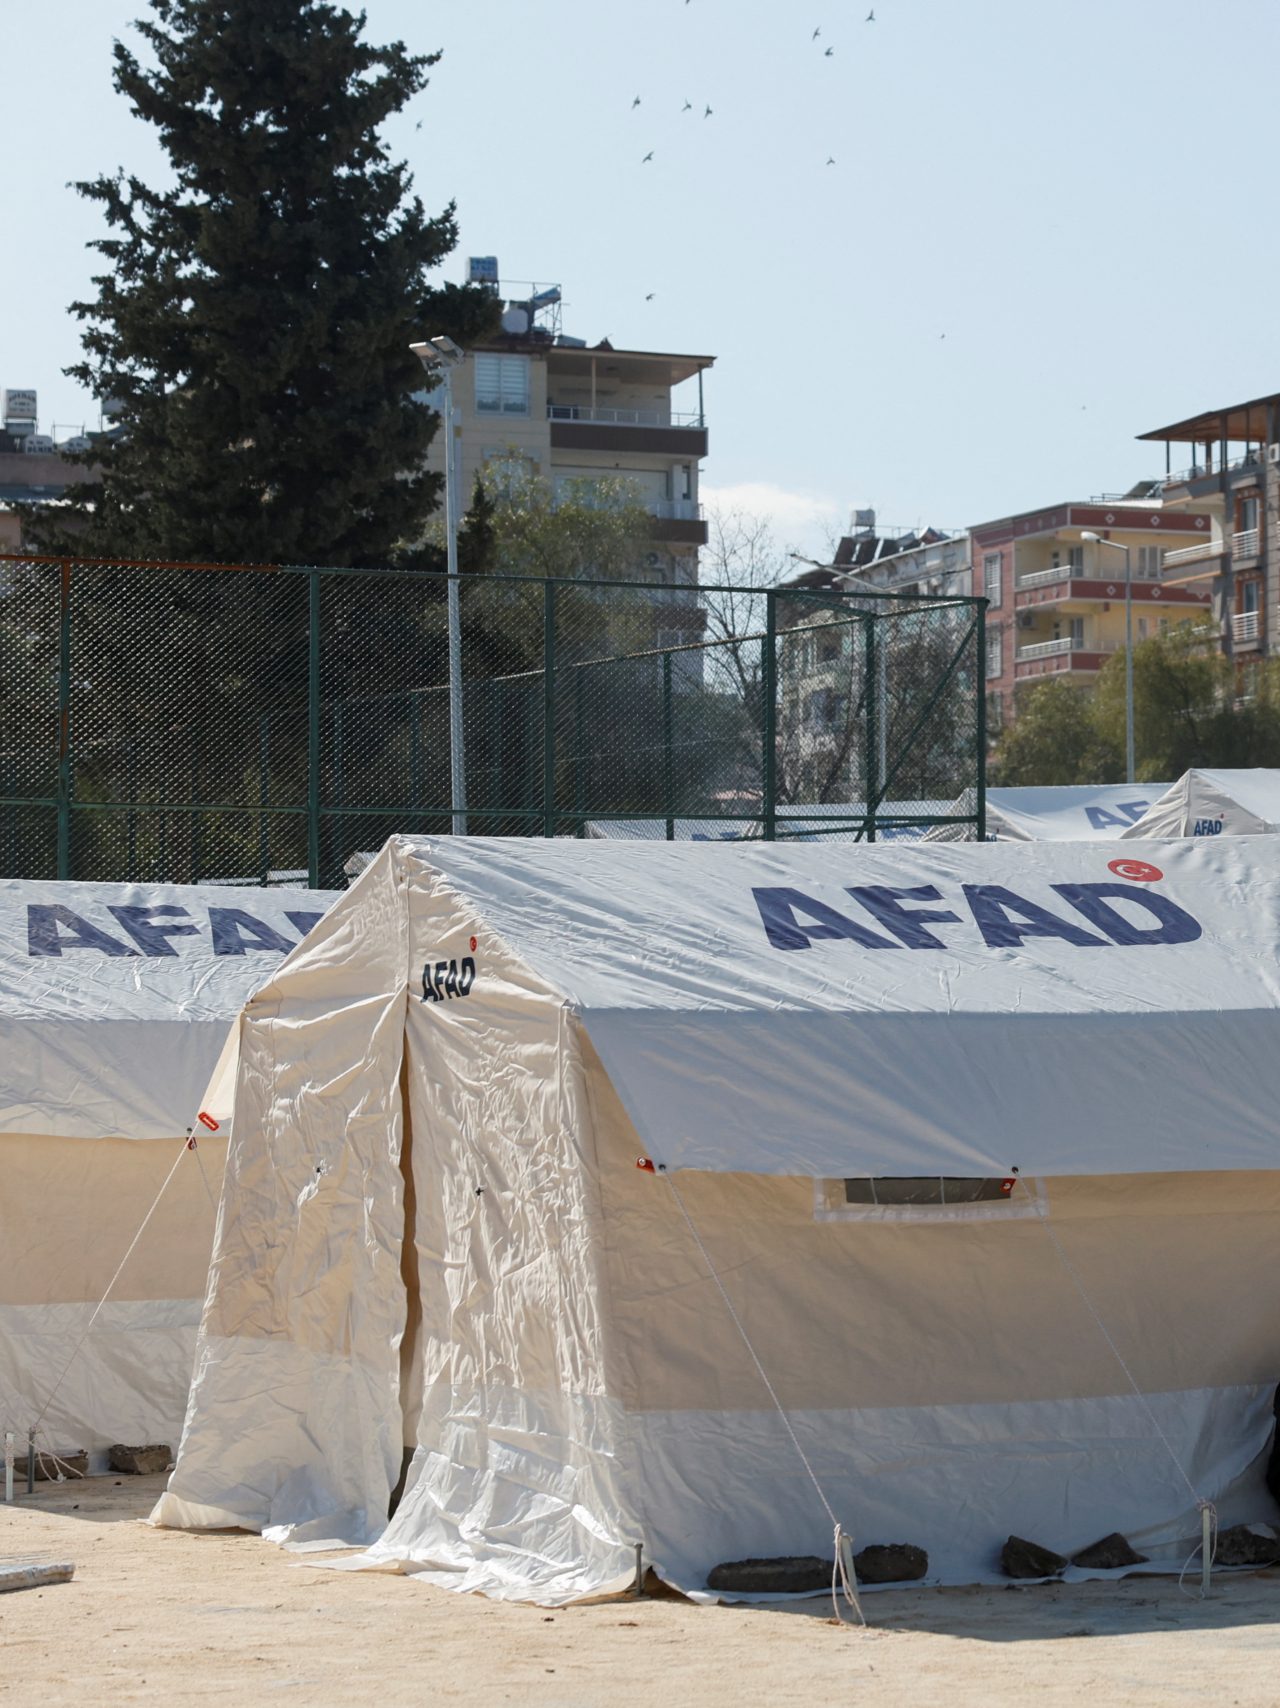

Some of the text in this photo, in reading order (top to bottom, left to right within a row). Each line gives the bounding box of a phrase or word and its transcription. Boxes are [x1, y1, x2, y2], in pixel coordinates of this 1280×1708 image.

[1193, 820, 1223, 837] AFAD
[751, 882, 1203, 950] AFAD
[420, 956, 477, 1003] AFAD
